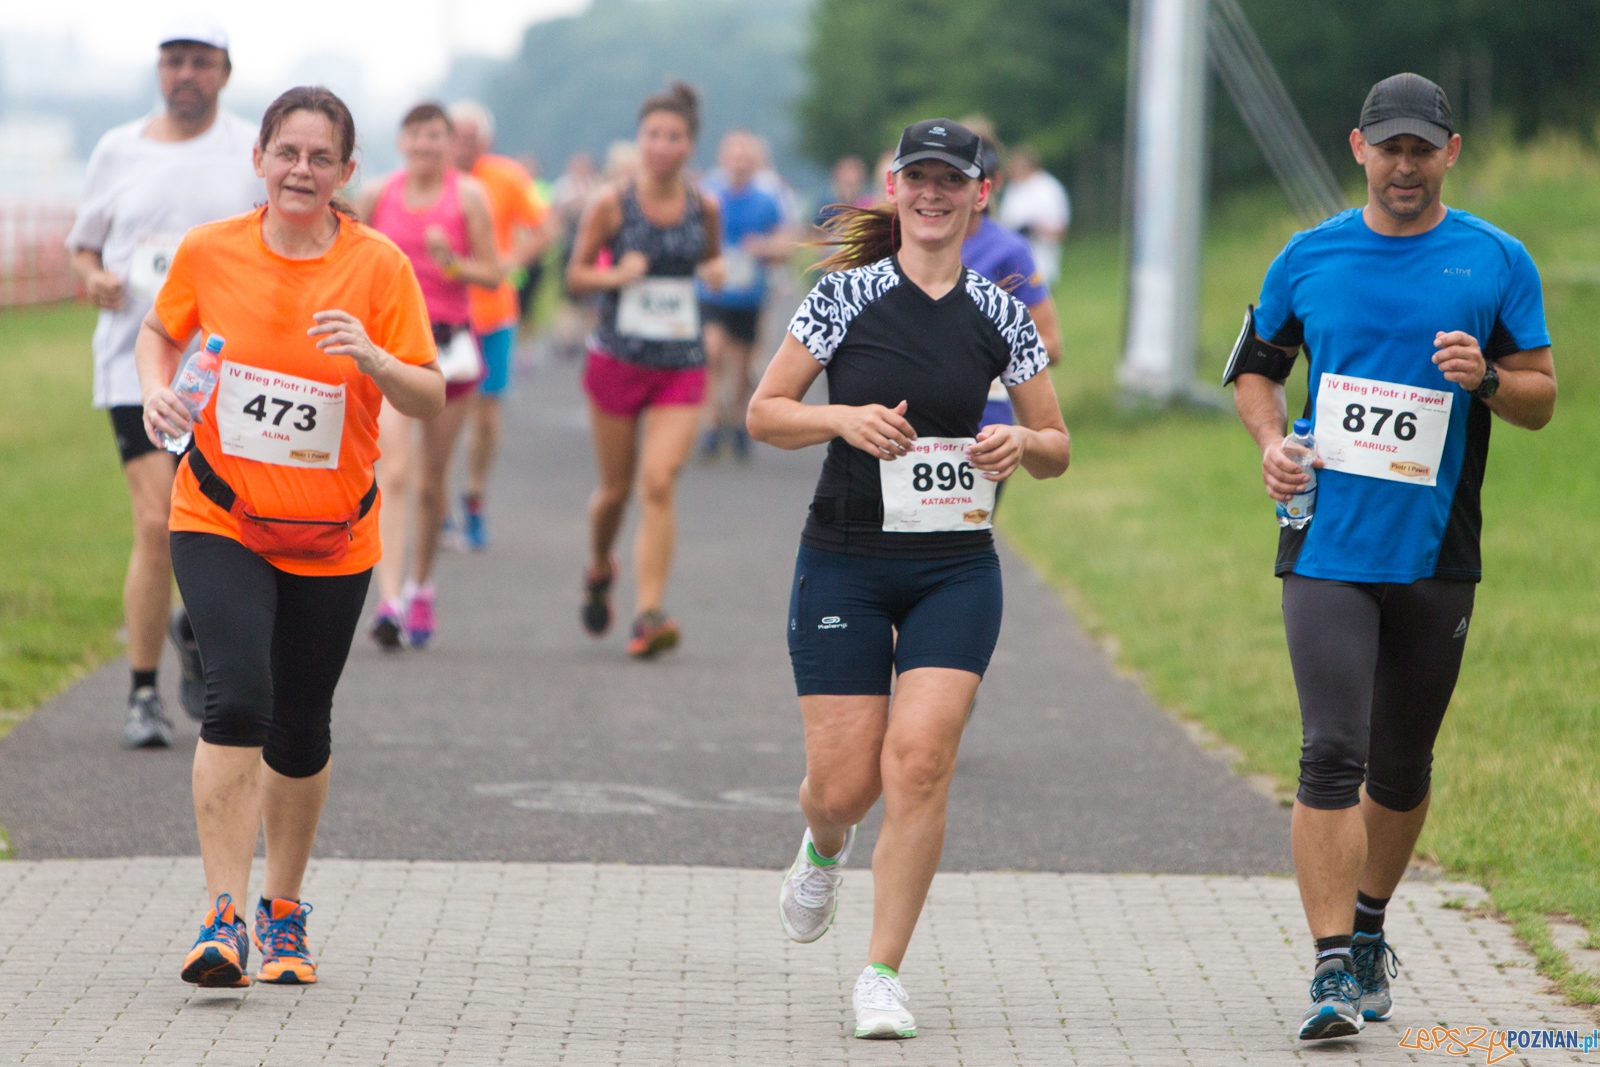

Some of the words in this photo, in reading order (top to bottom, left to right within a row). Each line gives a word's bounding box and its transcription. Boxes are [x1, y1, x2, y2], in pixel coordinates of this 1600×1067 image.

[229, 367, 242, 378] IV
[244, 371, 270, 387] Bieg
[273, 378, 300, 392] Piotr
[303, 384, 307, 394] i
[1327, 380, 1340, 389] IV
[1342, 381, 1368, 396] Bieg
[1371, 386, 1400, 399] Piotr
[1402, 391, 1407, 400] i
[243, 393, 317, 432] 473
[1342, 403, 1418, 441] 876
[261, 430, 291, 442] ALINA
[933, 442, 958, 452] Piotr
[1353, 439, 1399, 454] MARIUSZ
[912, 461, 975, 492] 896
[921, 497, 973, 506] KATARZYNA
